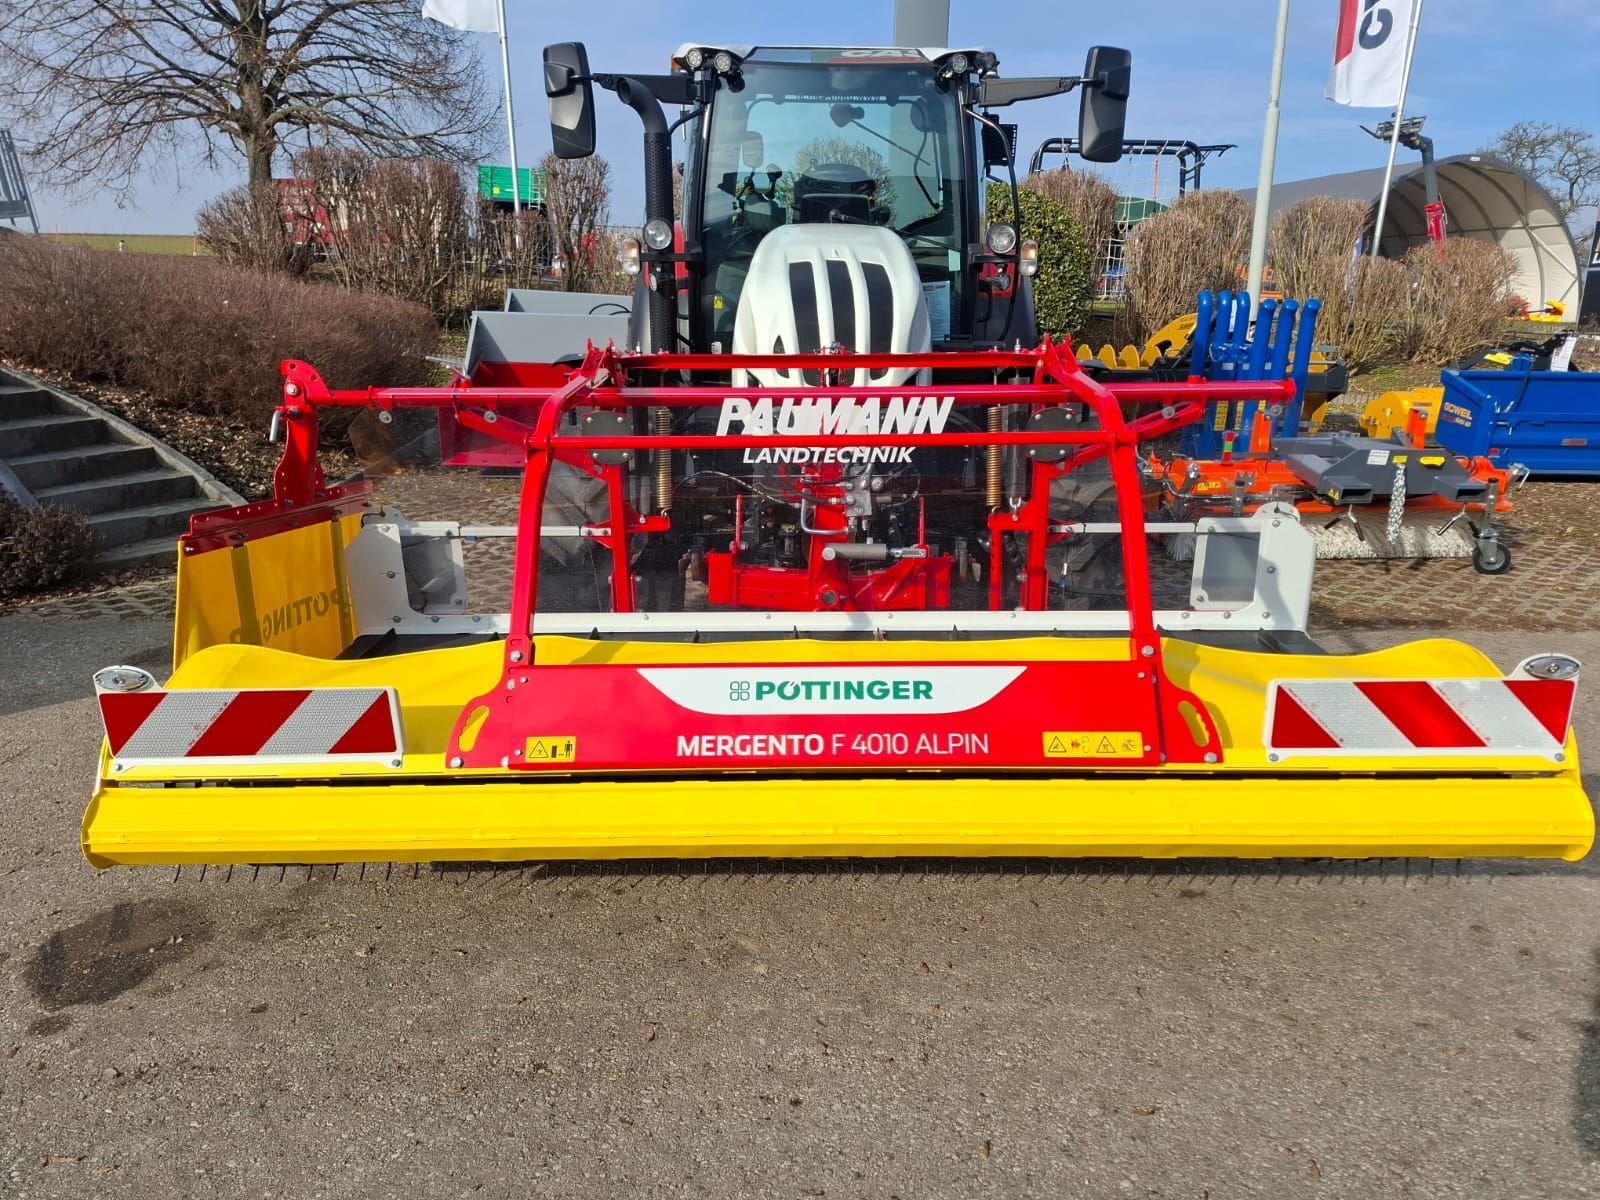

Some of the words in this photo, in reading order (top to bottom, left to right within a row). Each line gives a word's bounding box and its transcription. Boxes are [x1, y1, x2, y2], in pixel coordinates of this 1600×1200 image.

[716, 397, 956, 436] PAUMANN
[743, 447, 916, 464] LANDTECHNIK
[755, 680, 933, 700] PÖTTINGER
[677, 734, 824, 757] MERGENTO
[832, 734, 846, 755] F
[851, 733, 909, 755] 4010
[915, 733, 989, 755] ALPIN
